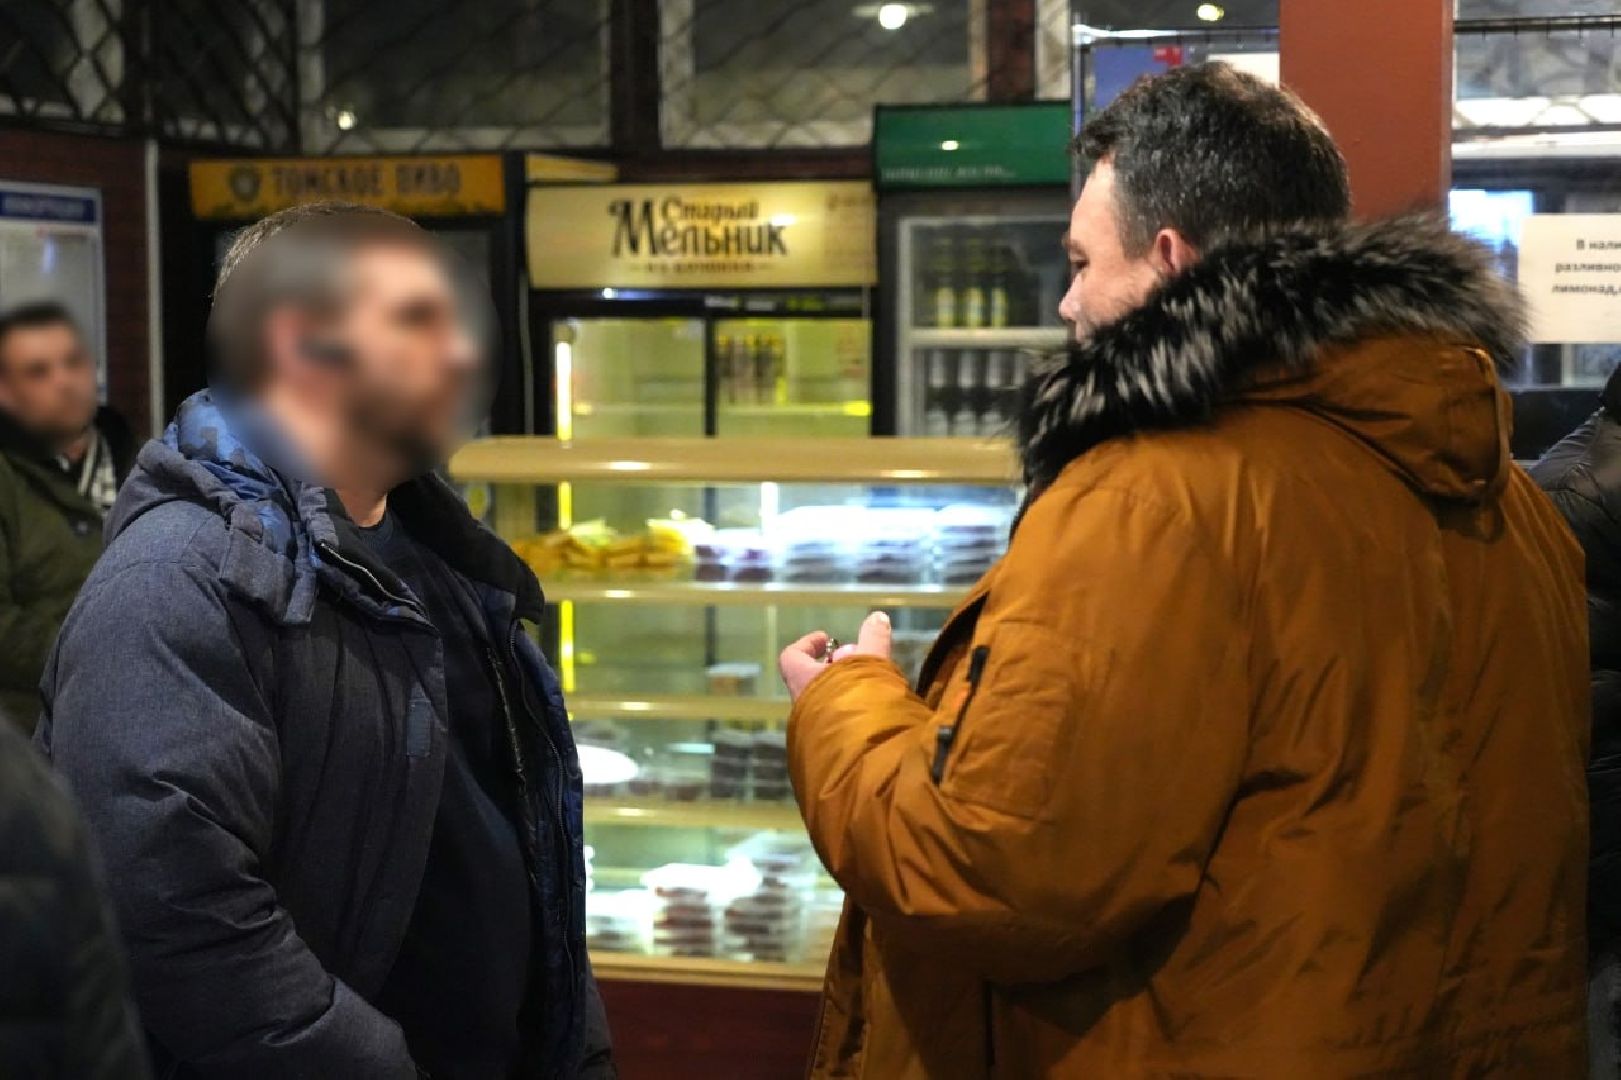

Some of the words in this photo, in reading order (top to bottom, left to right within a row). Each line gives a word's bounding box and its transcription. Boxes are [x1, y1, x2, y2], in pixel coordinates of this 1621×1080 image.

[271, 163, 382, 196] ТОМСКОЕ
[395, 163, 460, 195] ПИВО
[661, 196, 758, 226] Старый
[608, 199, 787, 257] Мельник
[1576, 239, 1585, 250] В
